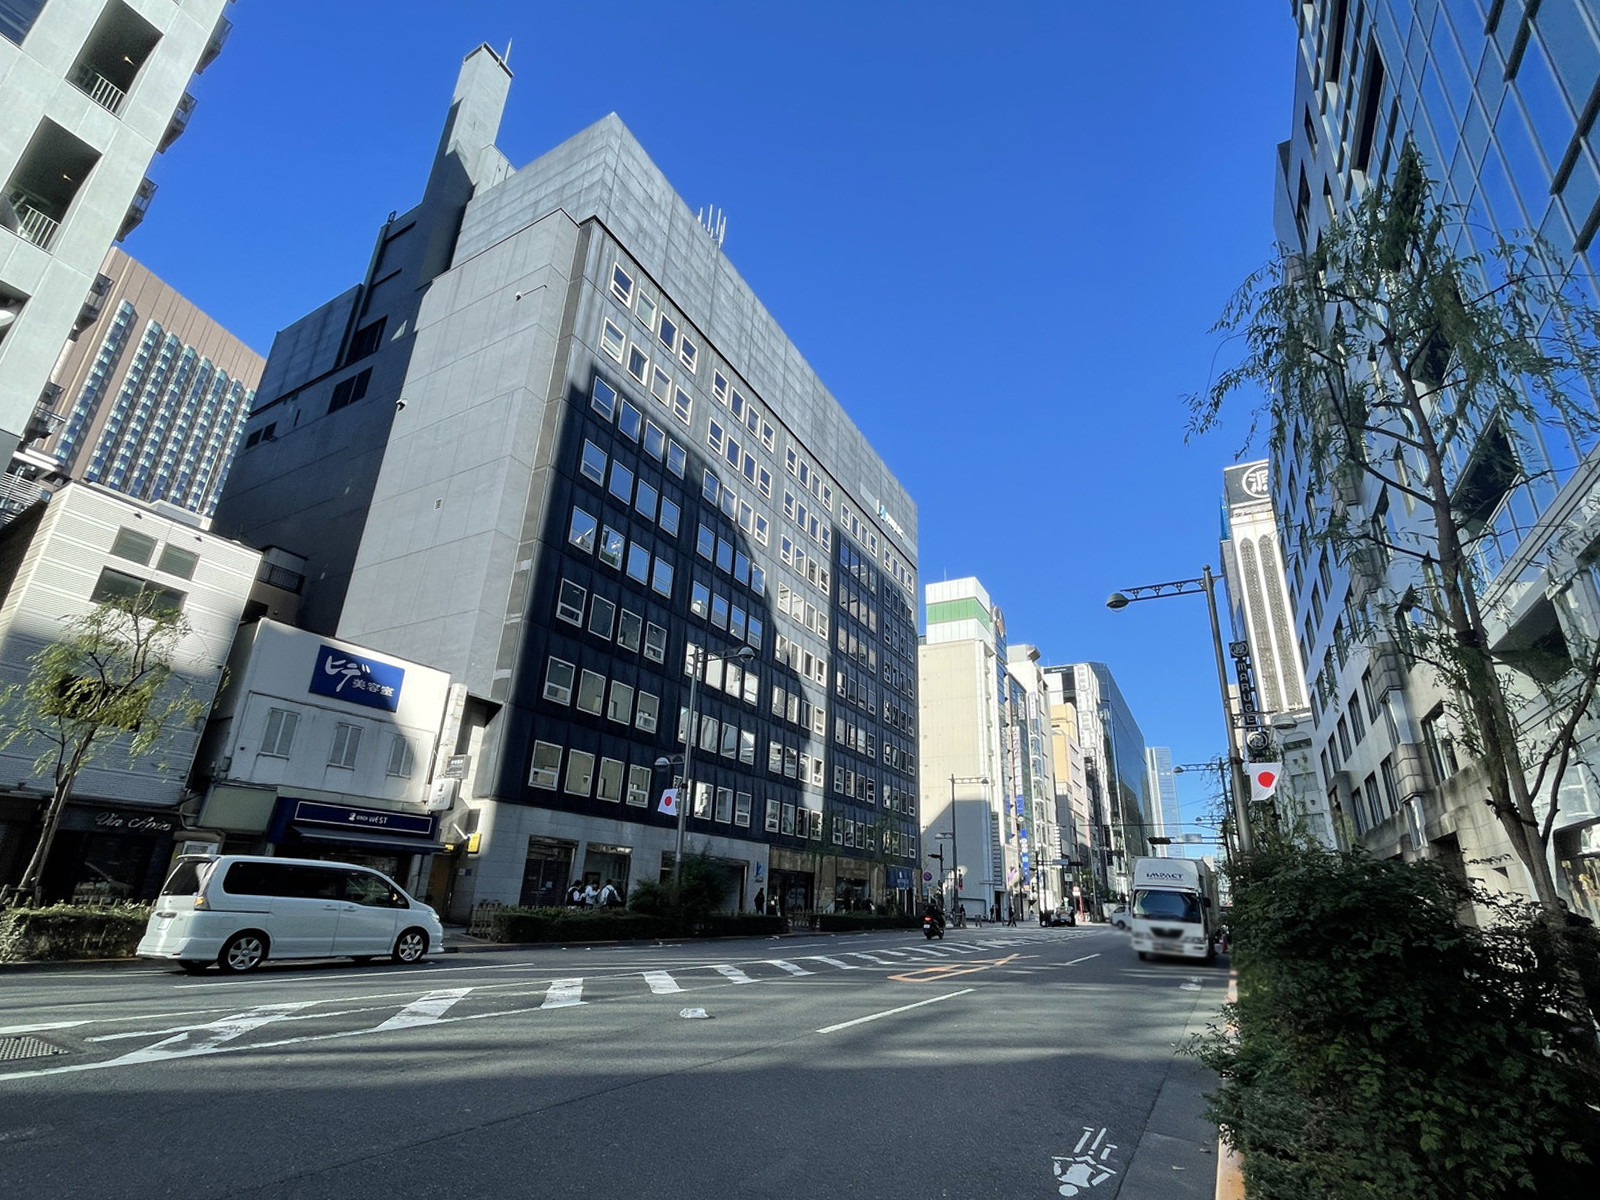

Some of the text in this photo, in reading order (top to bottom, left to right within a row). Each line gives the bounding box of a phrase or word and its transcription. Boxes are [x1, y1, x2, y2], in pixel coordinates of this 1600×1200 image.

[325, 655, 371, 693] ヒデ
[352, 678, 394, 697] 美容室
[1237, 661, 1257, 731] MARUGE
